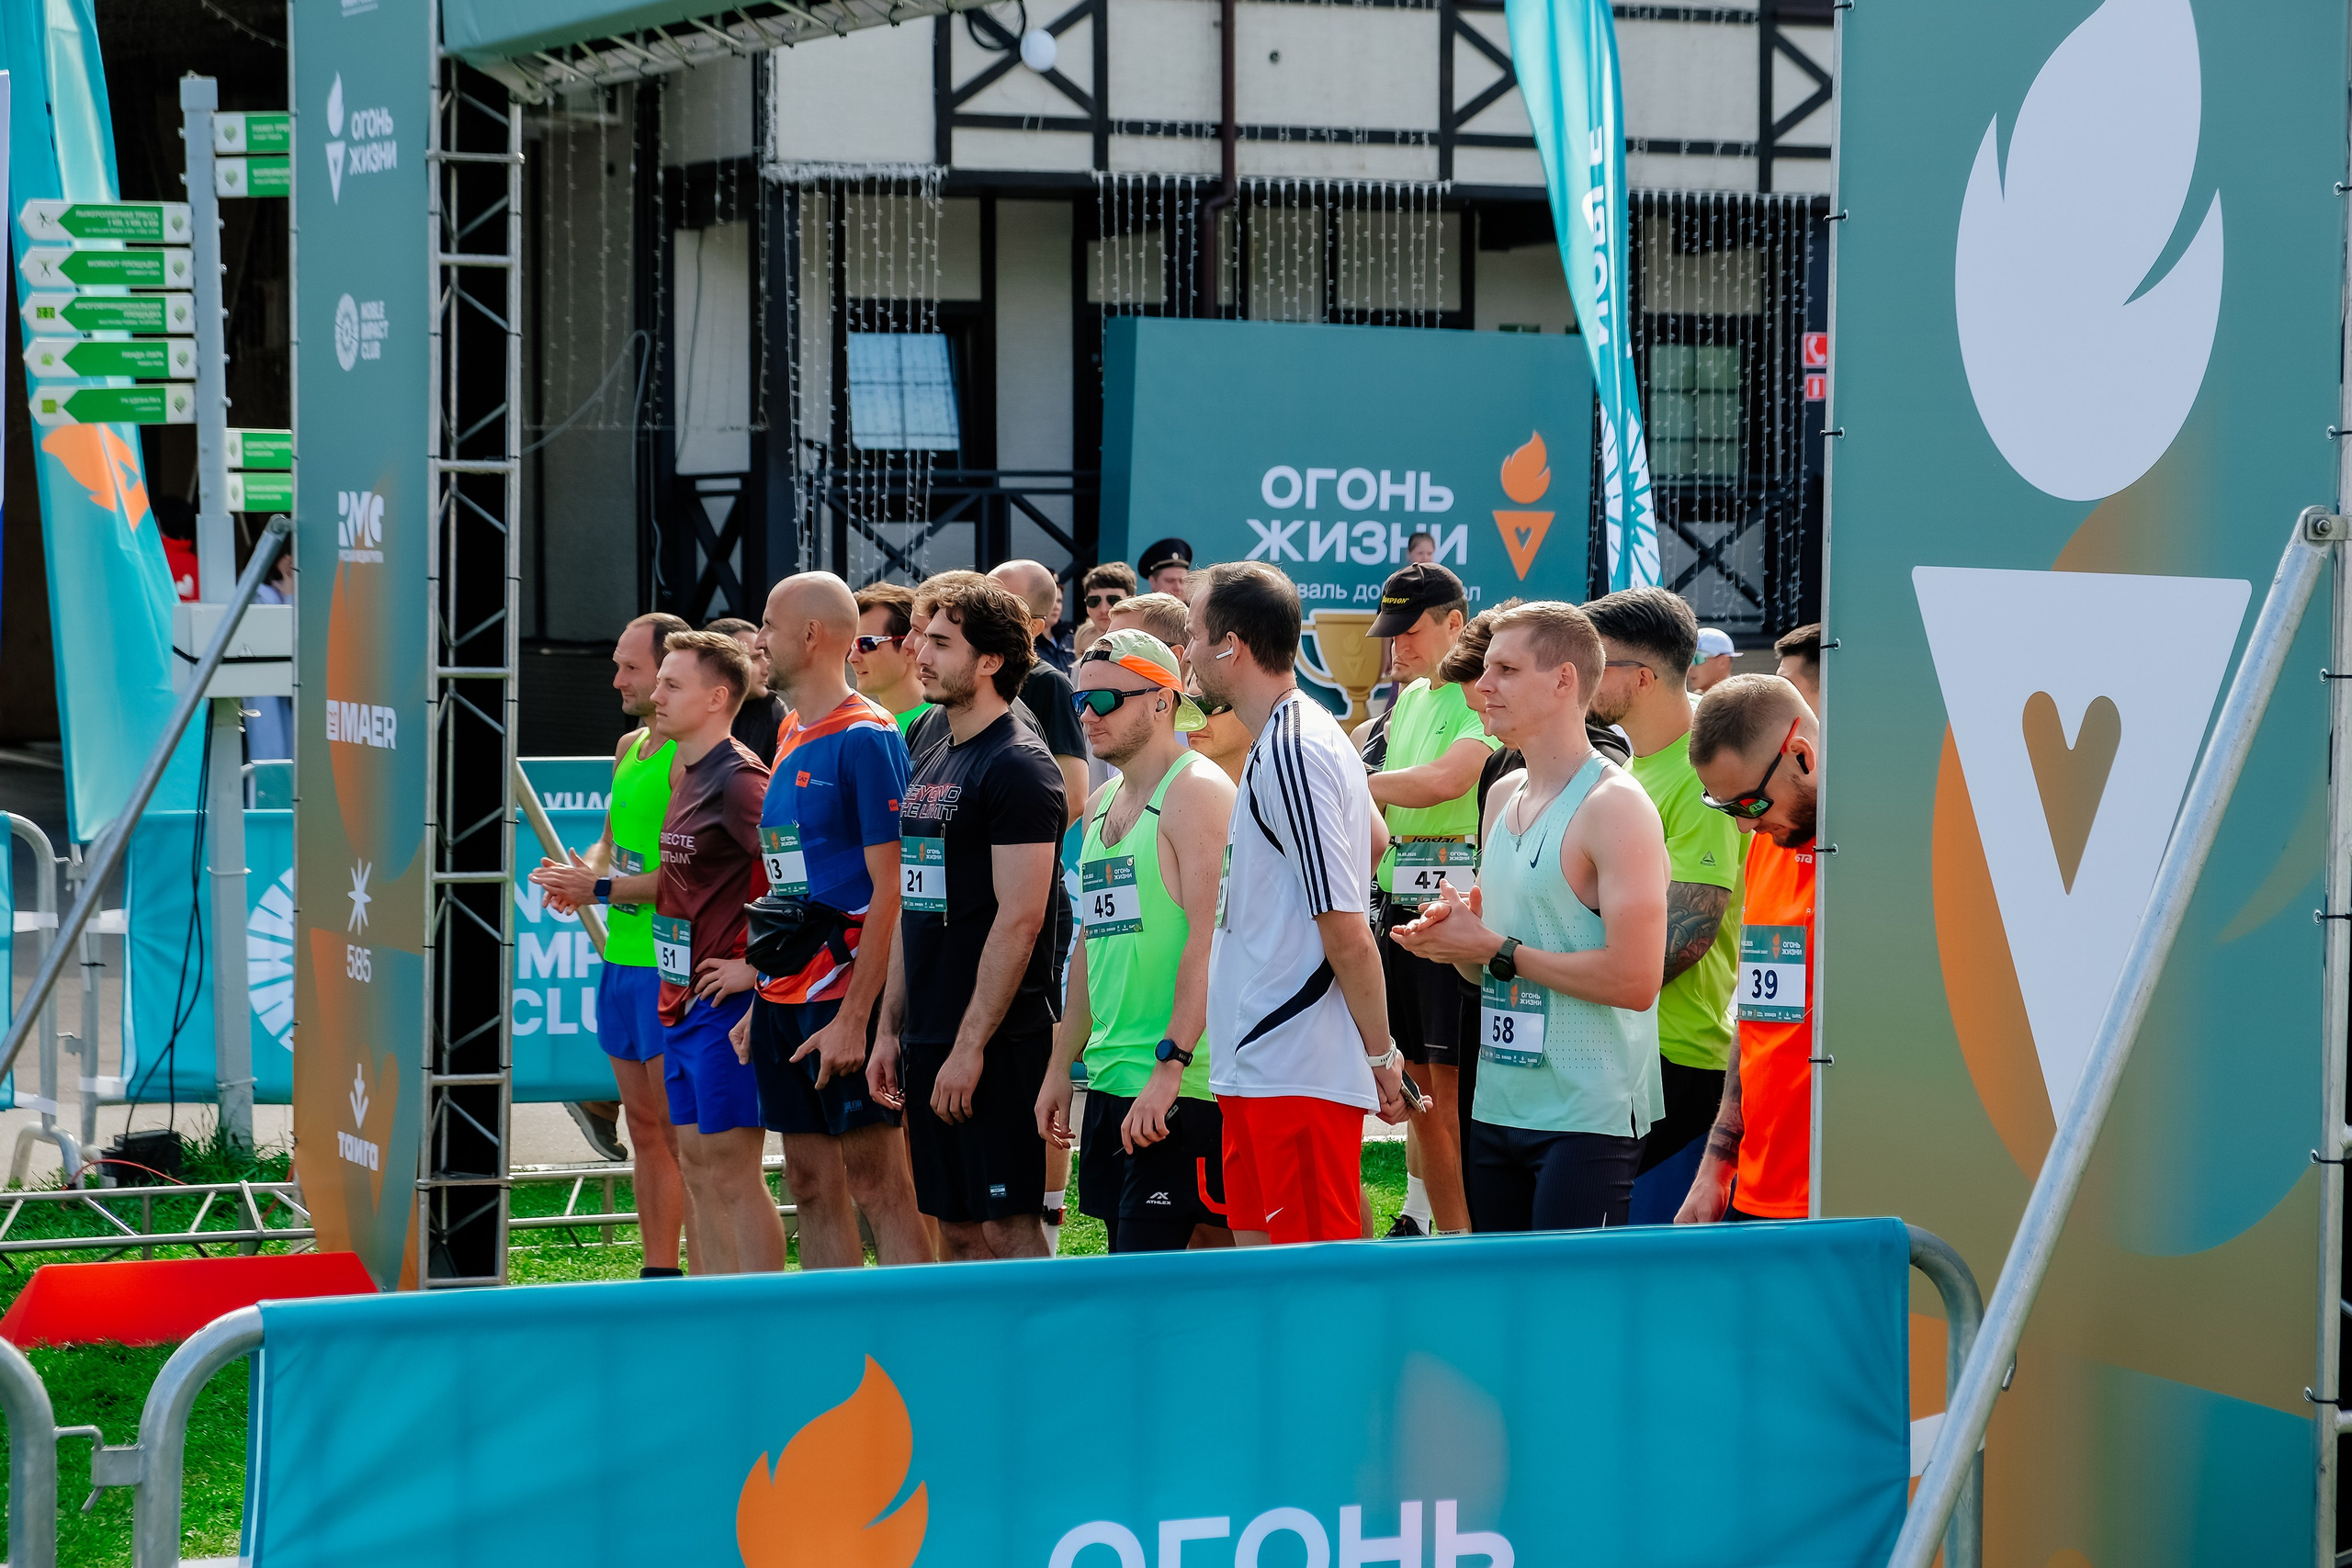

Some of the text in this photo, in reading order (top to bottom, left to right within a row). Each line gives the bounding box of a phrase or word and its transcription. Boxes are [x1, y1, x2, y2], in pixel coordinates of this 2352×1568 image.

[351, 107, 393, 141] ОГОНЬ
[349, 141, 397, 175] ЖИЗНИ
[1261, 465, 1455, 513] ОГОНЬ
[1245, 519, 1468, 565] ЖИЗНИ
[1352, 583, 1385, 603] до
[341, 701, 397, 750] MAER
[767, 859, 782, 879] 13
[907, 870, 922, 892] 21
[1415, 871, 1446, 889] 47
[1094, 894, 1114, 918] 45
[346, 944, 372, 983] 585
[663, 947, 675, 968] 51
[1752, 969, 1778, 999] 39
[1492, 1015, 1514, 1043] 58
[1048, 1500, 1515, 1568] ОГОНЬ
